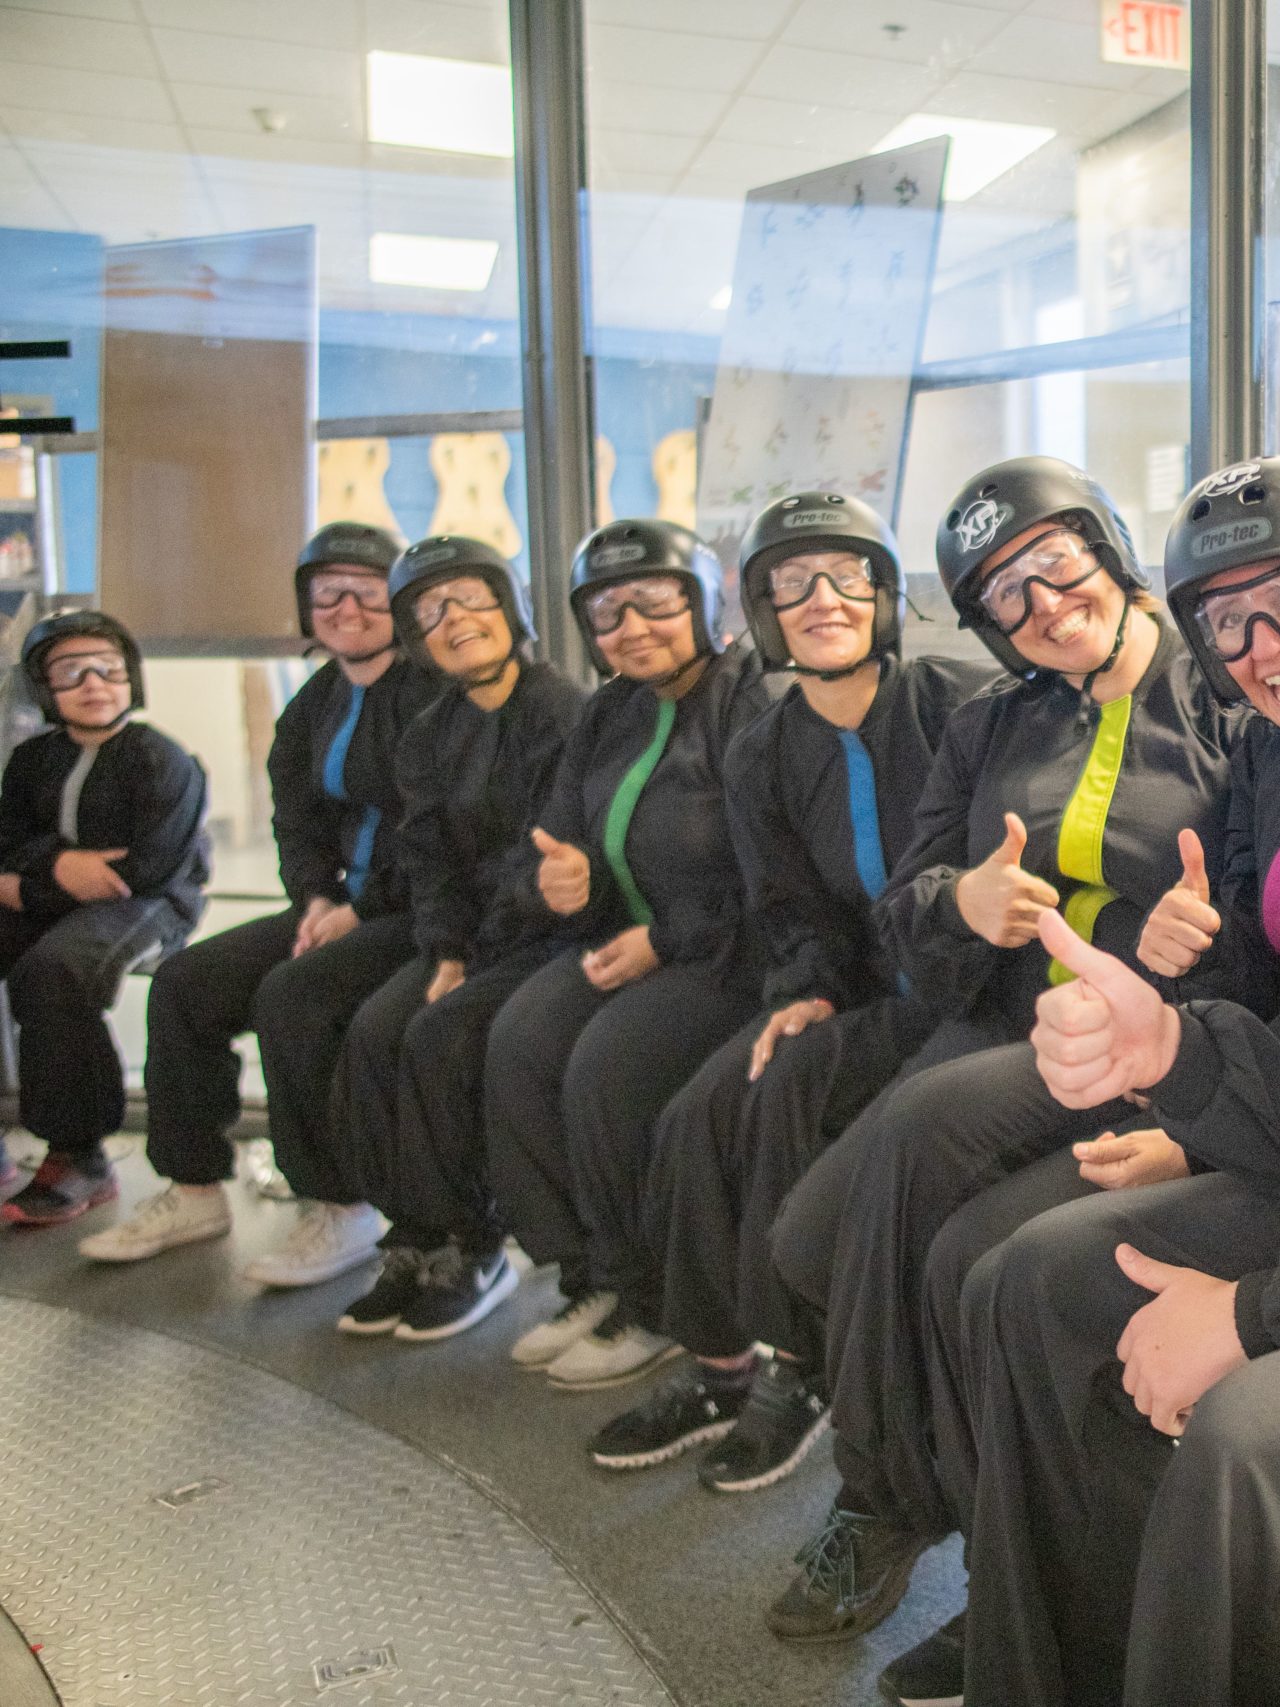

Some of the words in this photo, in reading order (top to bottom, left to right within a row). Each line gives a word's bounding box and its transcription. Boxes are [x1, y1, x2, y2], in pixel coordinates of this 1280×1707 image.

[1120, 2, 1183, 61] EXIT
[791, 511, 842, 526] Pro-tec
[956, 501, 998, 552] XP
[1201, 523, 1260, 553] Pro-tec
